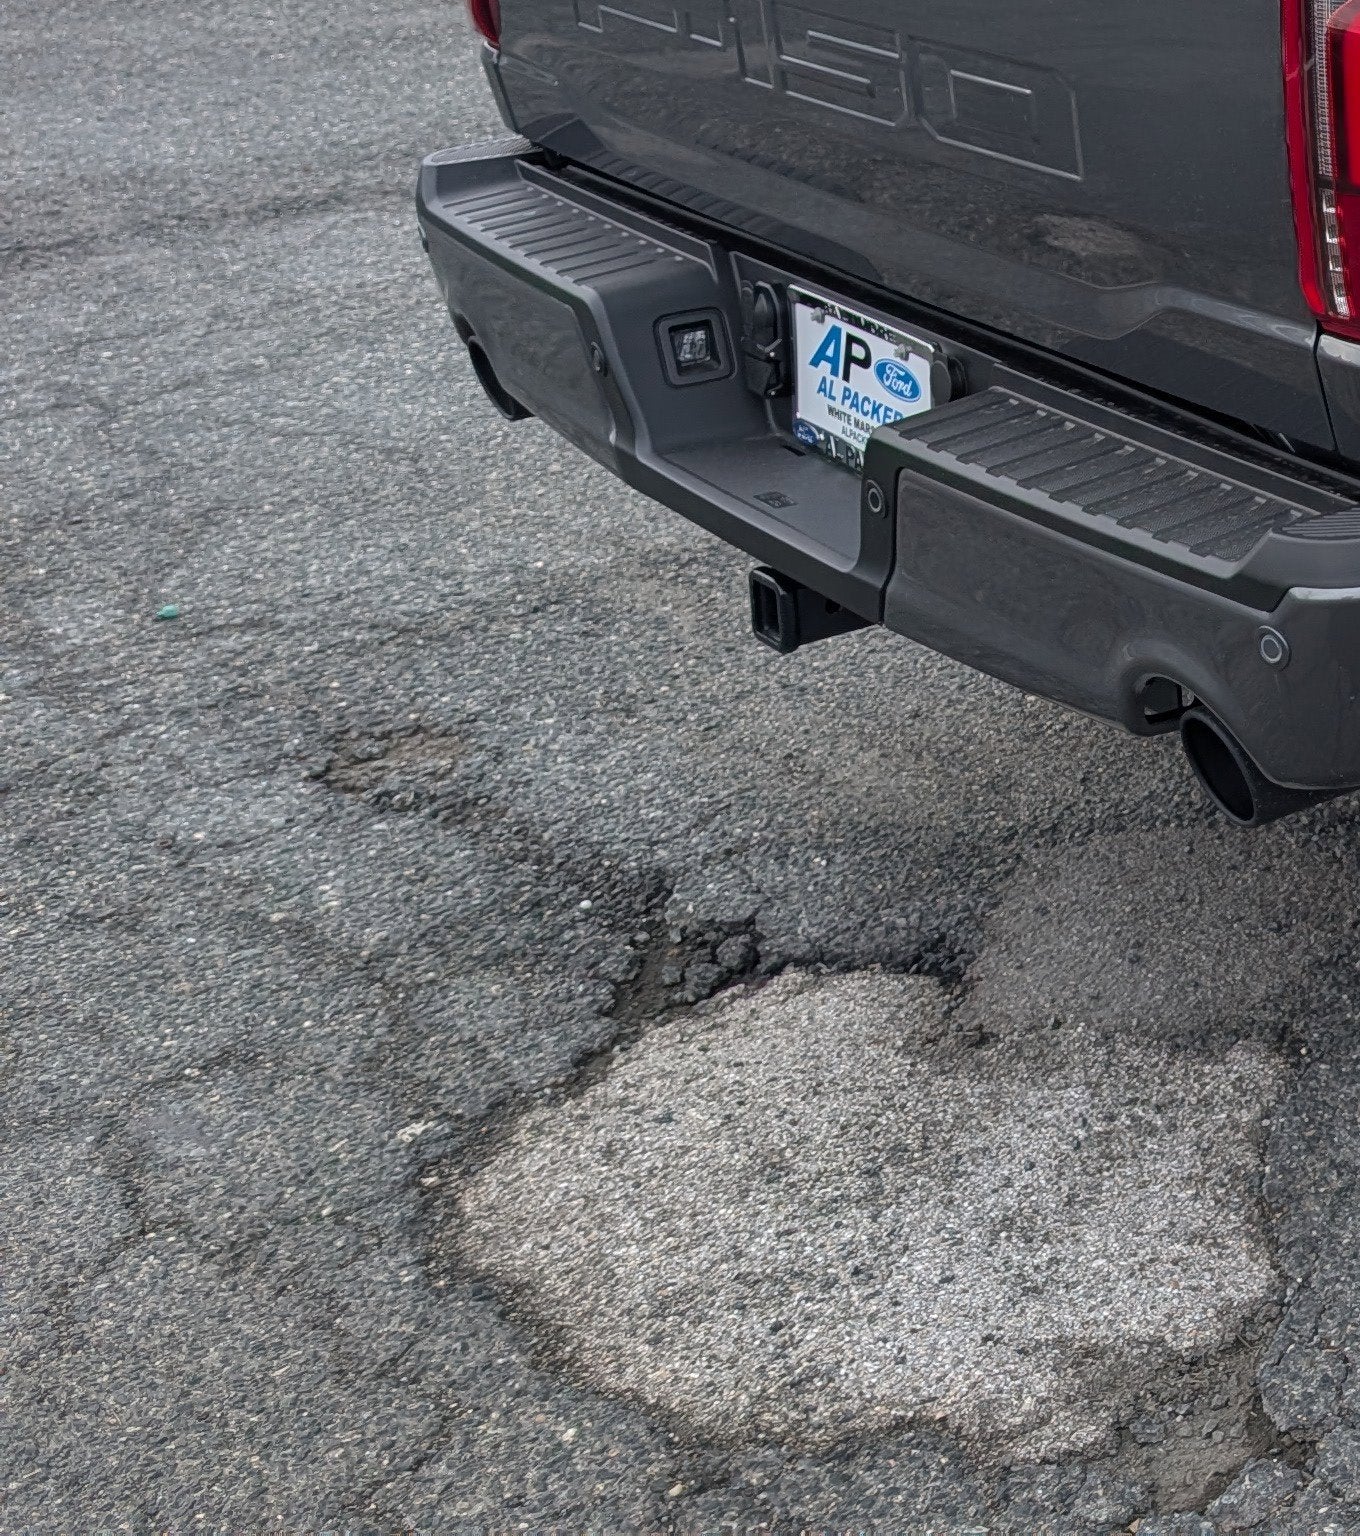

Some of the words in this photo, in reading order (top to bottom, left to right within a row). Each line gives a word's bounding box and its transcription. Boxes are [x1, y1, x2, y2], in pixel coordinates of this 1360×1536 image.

[809, 324, 872, 384] AP
[882, 362, 914, 398] Ford
[817, 376, 837, 402] AL
[827, 405, 852, 426] WHITE
[854, 417, 873, 434] MAR
